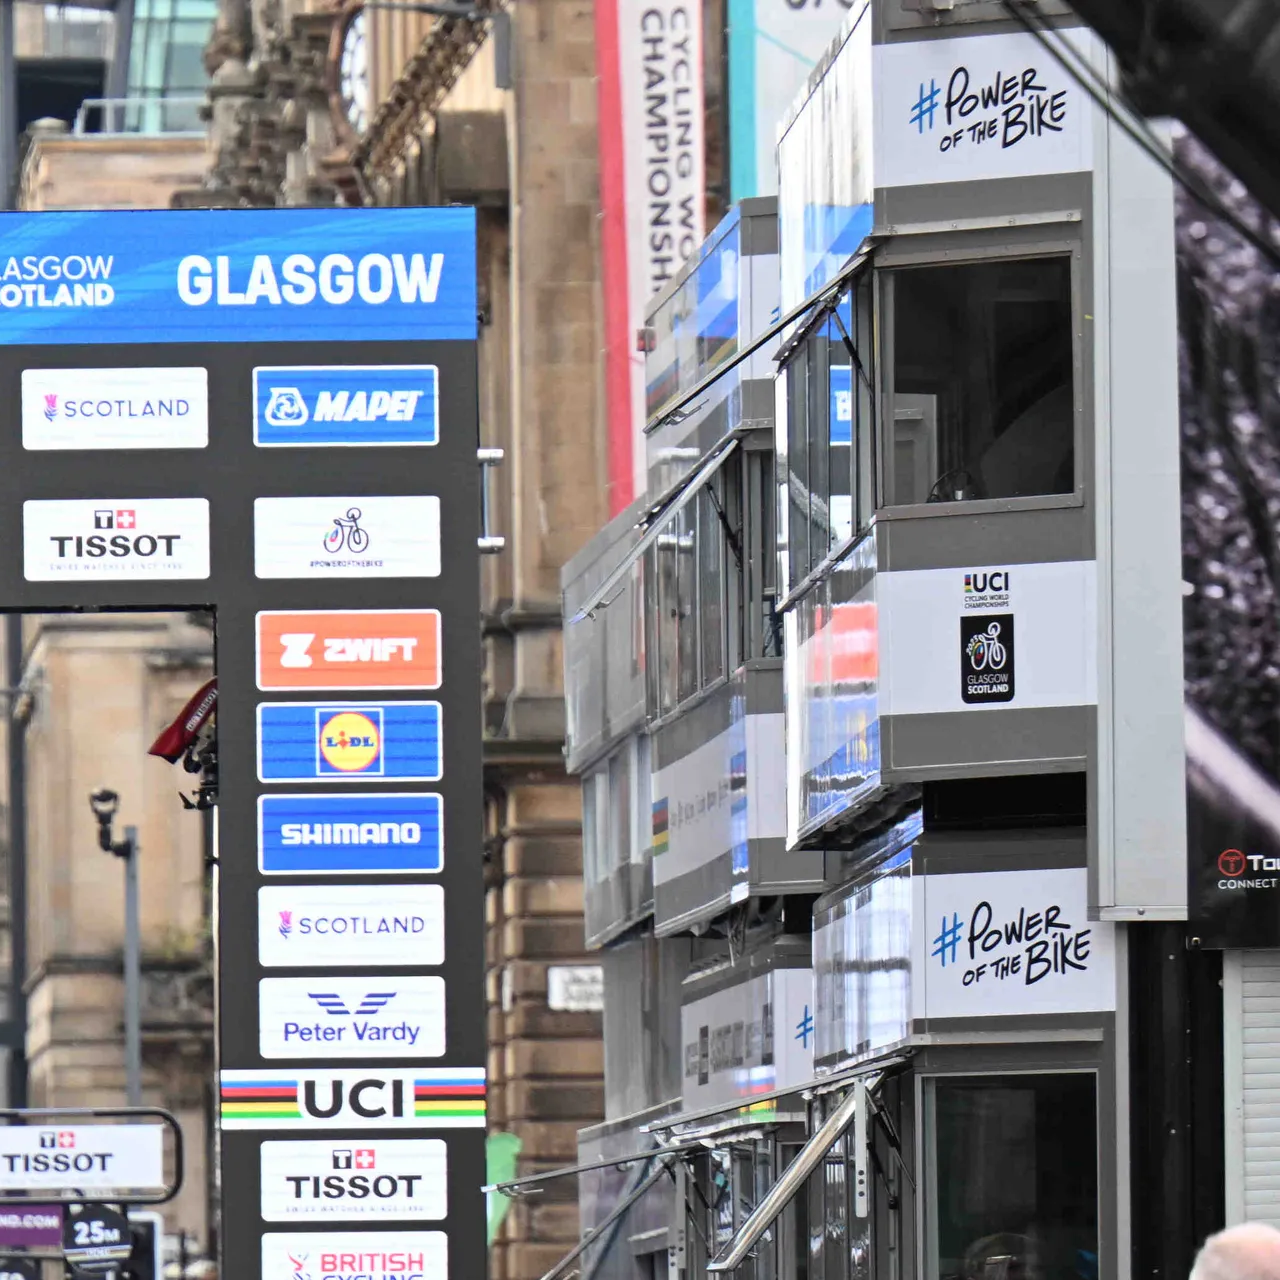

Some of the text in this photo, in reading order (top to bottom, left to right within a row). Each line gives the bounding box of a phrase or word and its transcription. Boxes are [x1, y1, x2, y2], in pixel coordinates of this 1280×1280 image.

[671, 7, 694, 180] CYCLING
[969, 118, 997, 144] THE
[641, 10, 673, 292] CHAMPIONSH
[176, 252, 444, 305] GLASGOW
[66, 399, 189, 418] SCOTLAND
[313, 390, 424, 422] MAPEI
[50, 534, 180, 558] TISSOT
[973, 572, 1008, 592] UCI
[965, 601, 1009, 609] CHAMPIONSHIPS
[324, 638, 417, 661] ZWIFT
[967, 674, 1008, 684] GLASGOW
[968, 684, 1008, 694] SCOTLAND
[281, 823, 420, 844] SHIMANO
[1218, 879, 1278, 889] CONNECT
[300, 917, 424, 934] SCOTLAND
[995, 953, 1021, 977] THE
[284, 1021, 419, 1045] Peter Vardy
[304, 1078, 403, 1118] UCI
[2, 1153, 114, 1173] TISSOT
[286, 1176, 422, 1199] TISSOT
[321, 1254, 423, 1271] BRITISH
